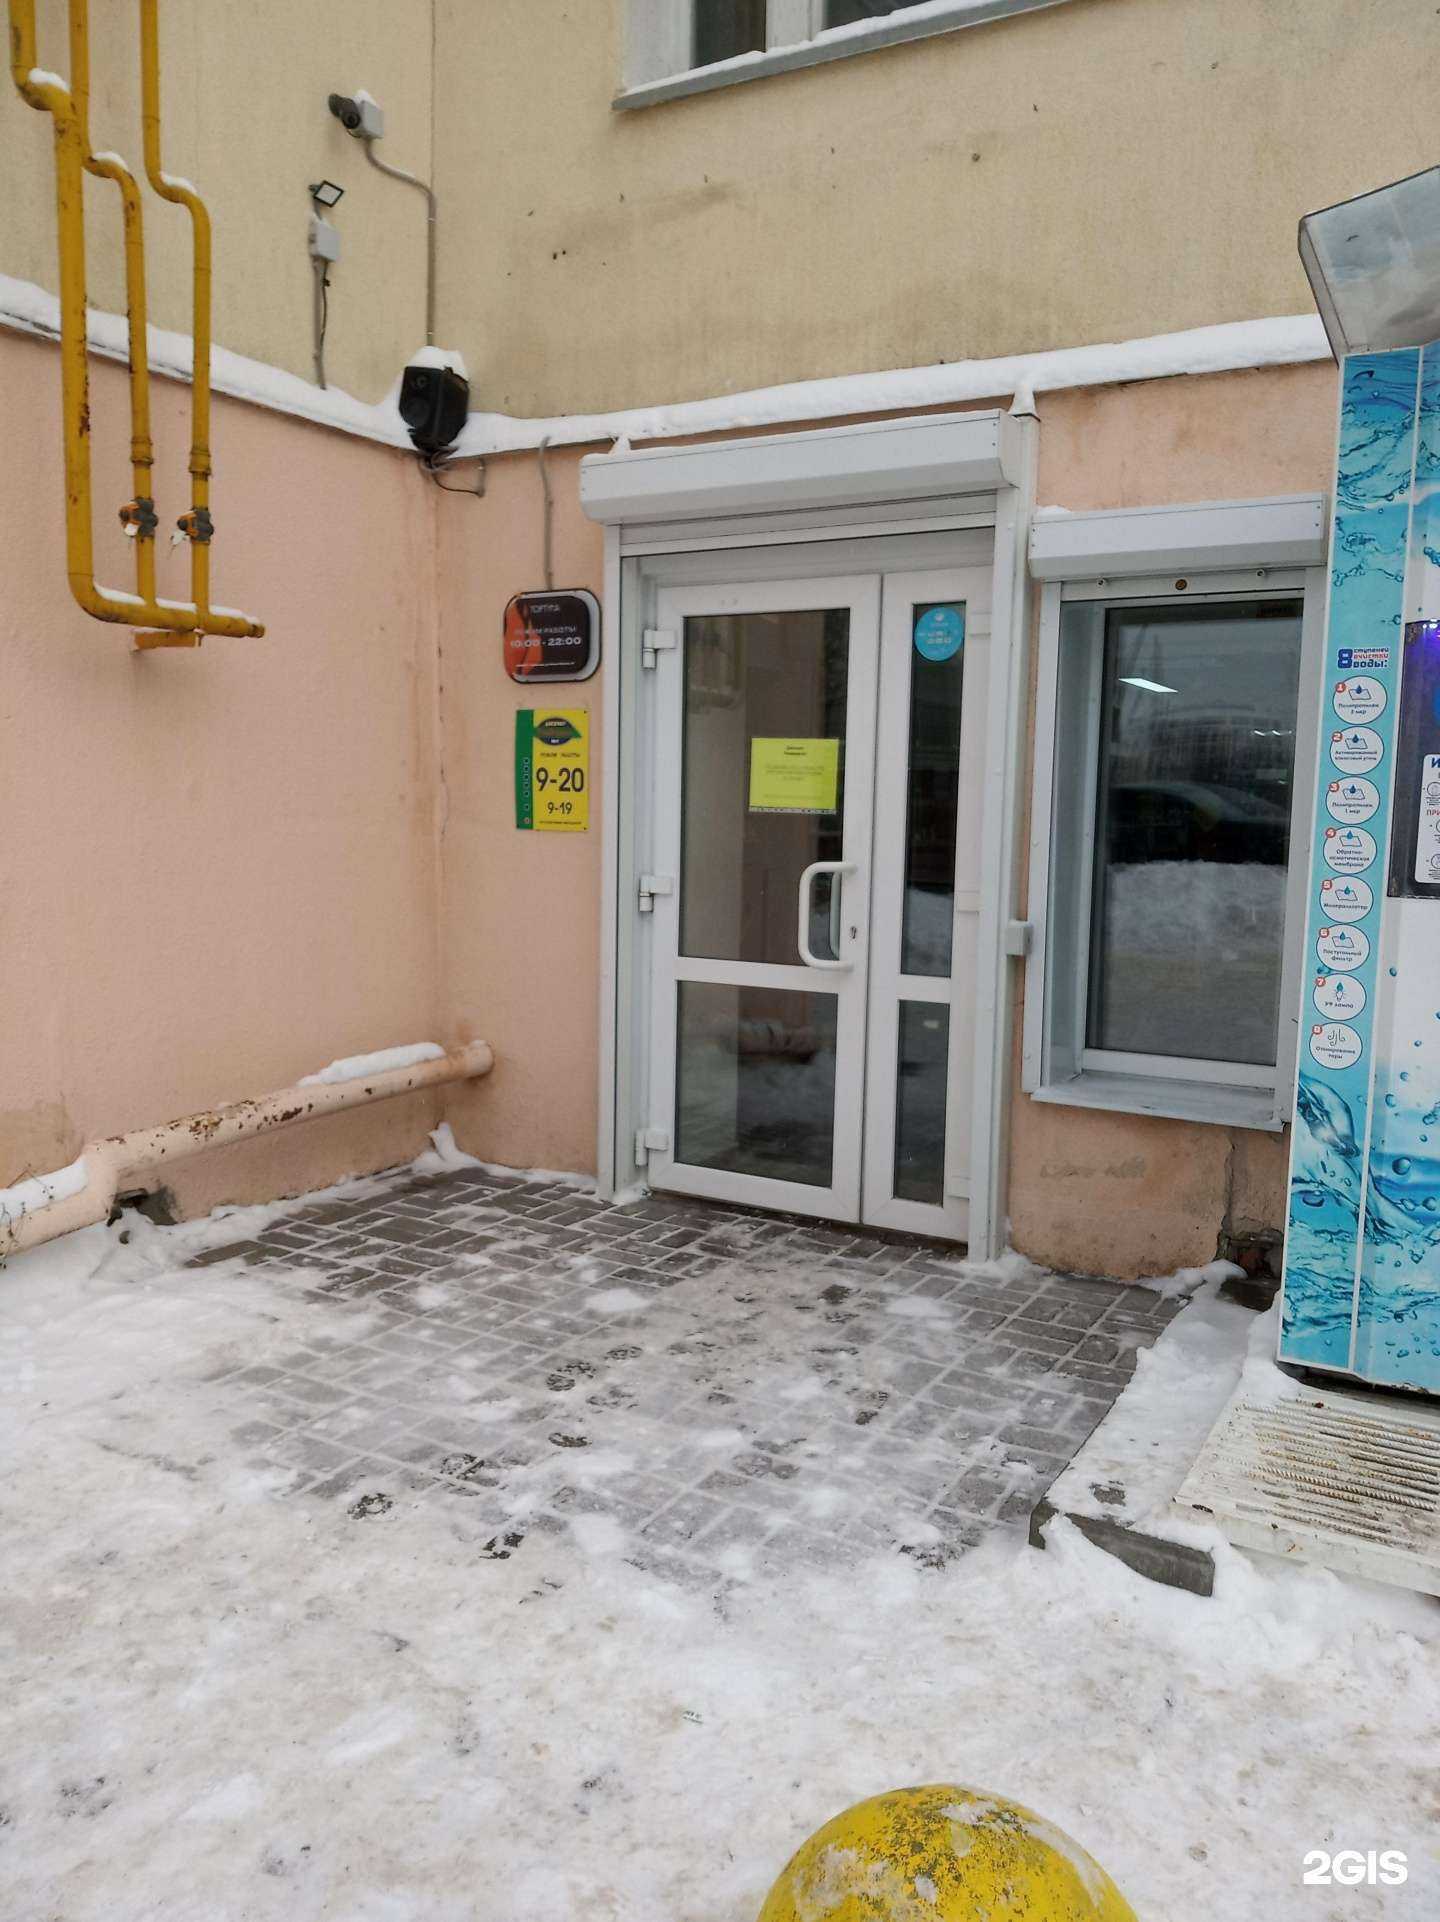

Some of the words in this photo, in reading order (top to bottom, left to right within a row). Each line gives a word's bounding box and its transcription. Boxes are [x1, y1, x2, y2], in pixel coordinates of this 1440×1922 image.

[547, 636, 582, 647] 22:00
[1337, 649, 1354, 669] 8
[1353, 659, 1388, 668] воды:
[536, 767, 584, 792] 9-20
[547, 802, 573, 814] 9-19
